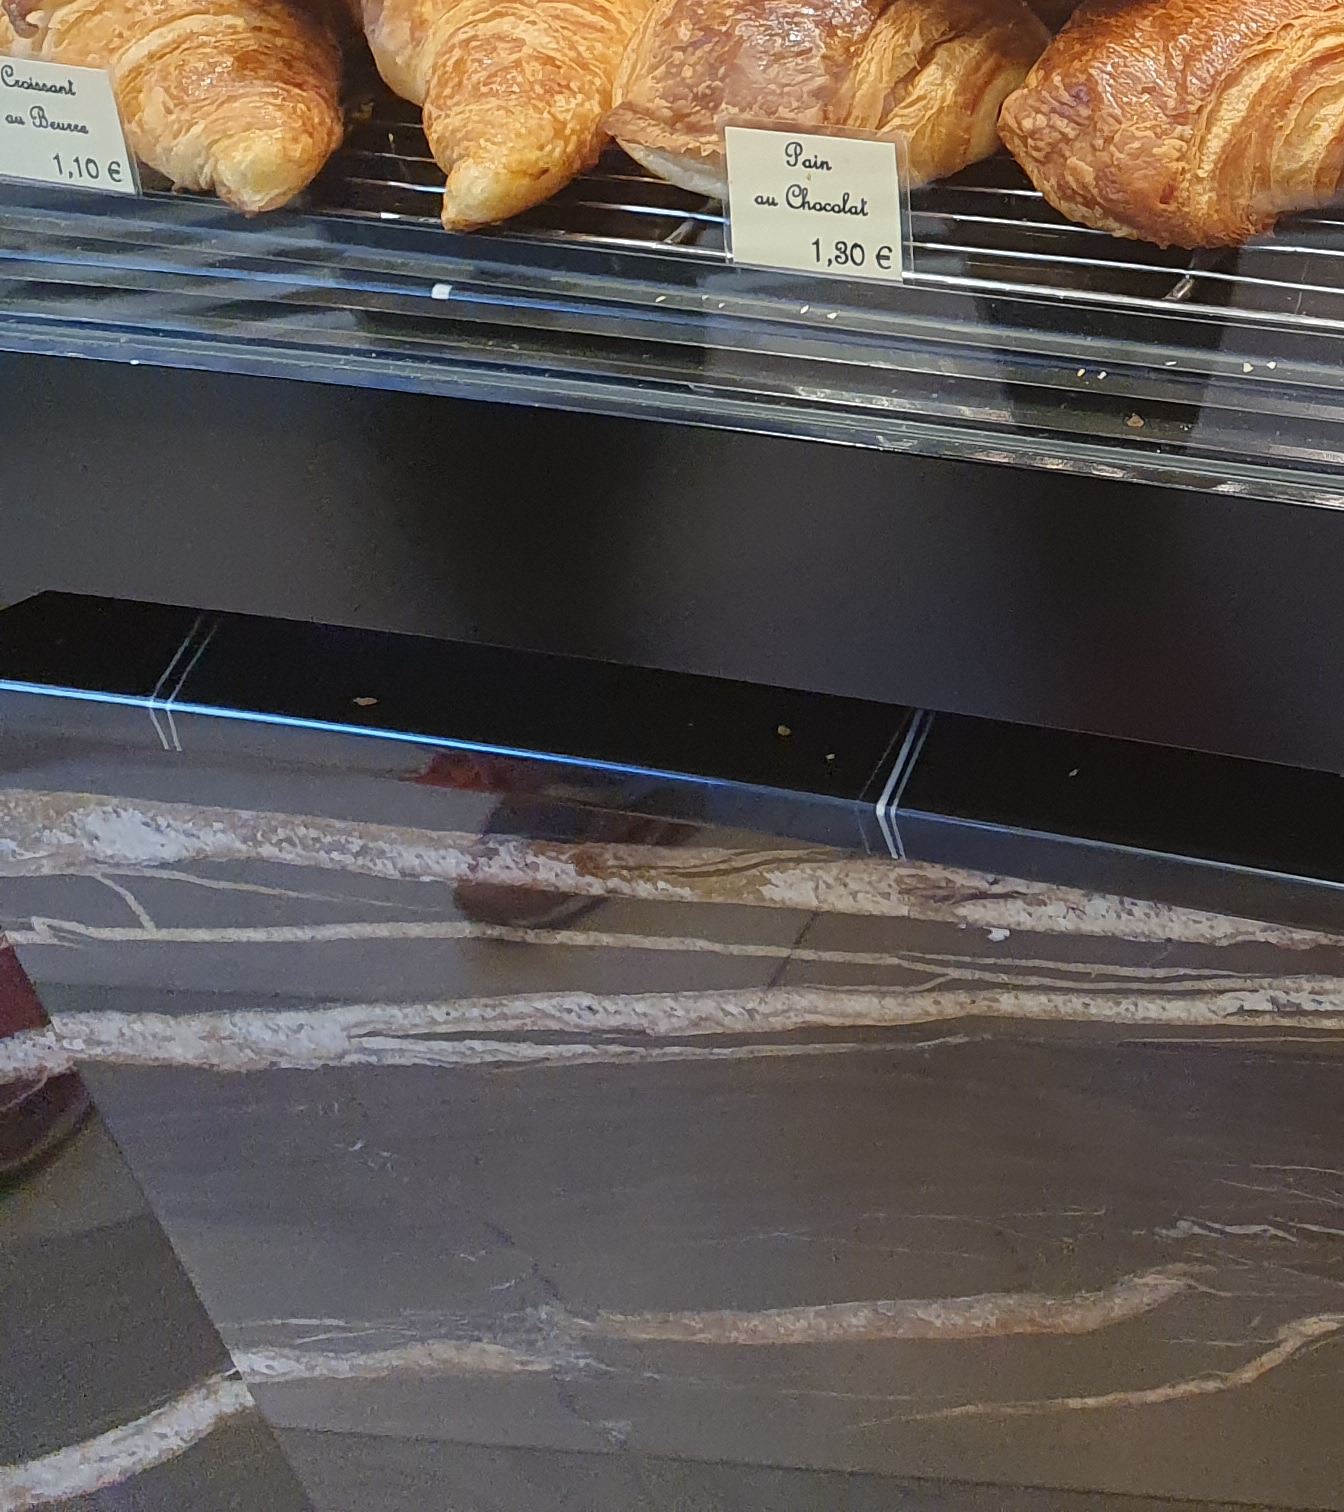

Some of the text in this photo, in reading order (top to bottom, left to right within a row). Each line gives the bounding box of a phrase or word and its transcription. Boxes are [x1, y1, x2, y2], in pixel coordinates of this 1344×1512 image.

[1, 65, 76, 96] Croissant
[5, 106, 89, 134] au Beurre
[53, 153, 122, 182] 1,10 €
[785, 141, 832, 171] Pain
[754, 184, 869, 217] au Chocolat
[811, 238, 893, 270] 1,30 €
